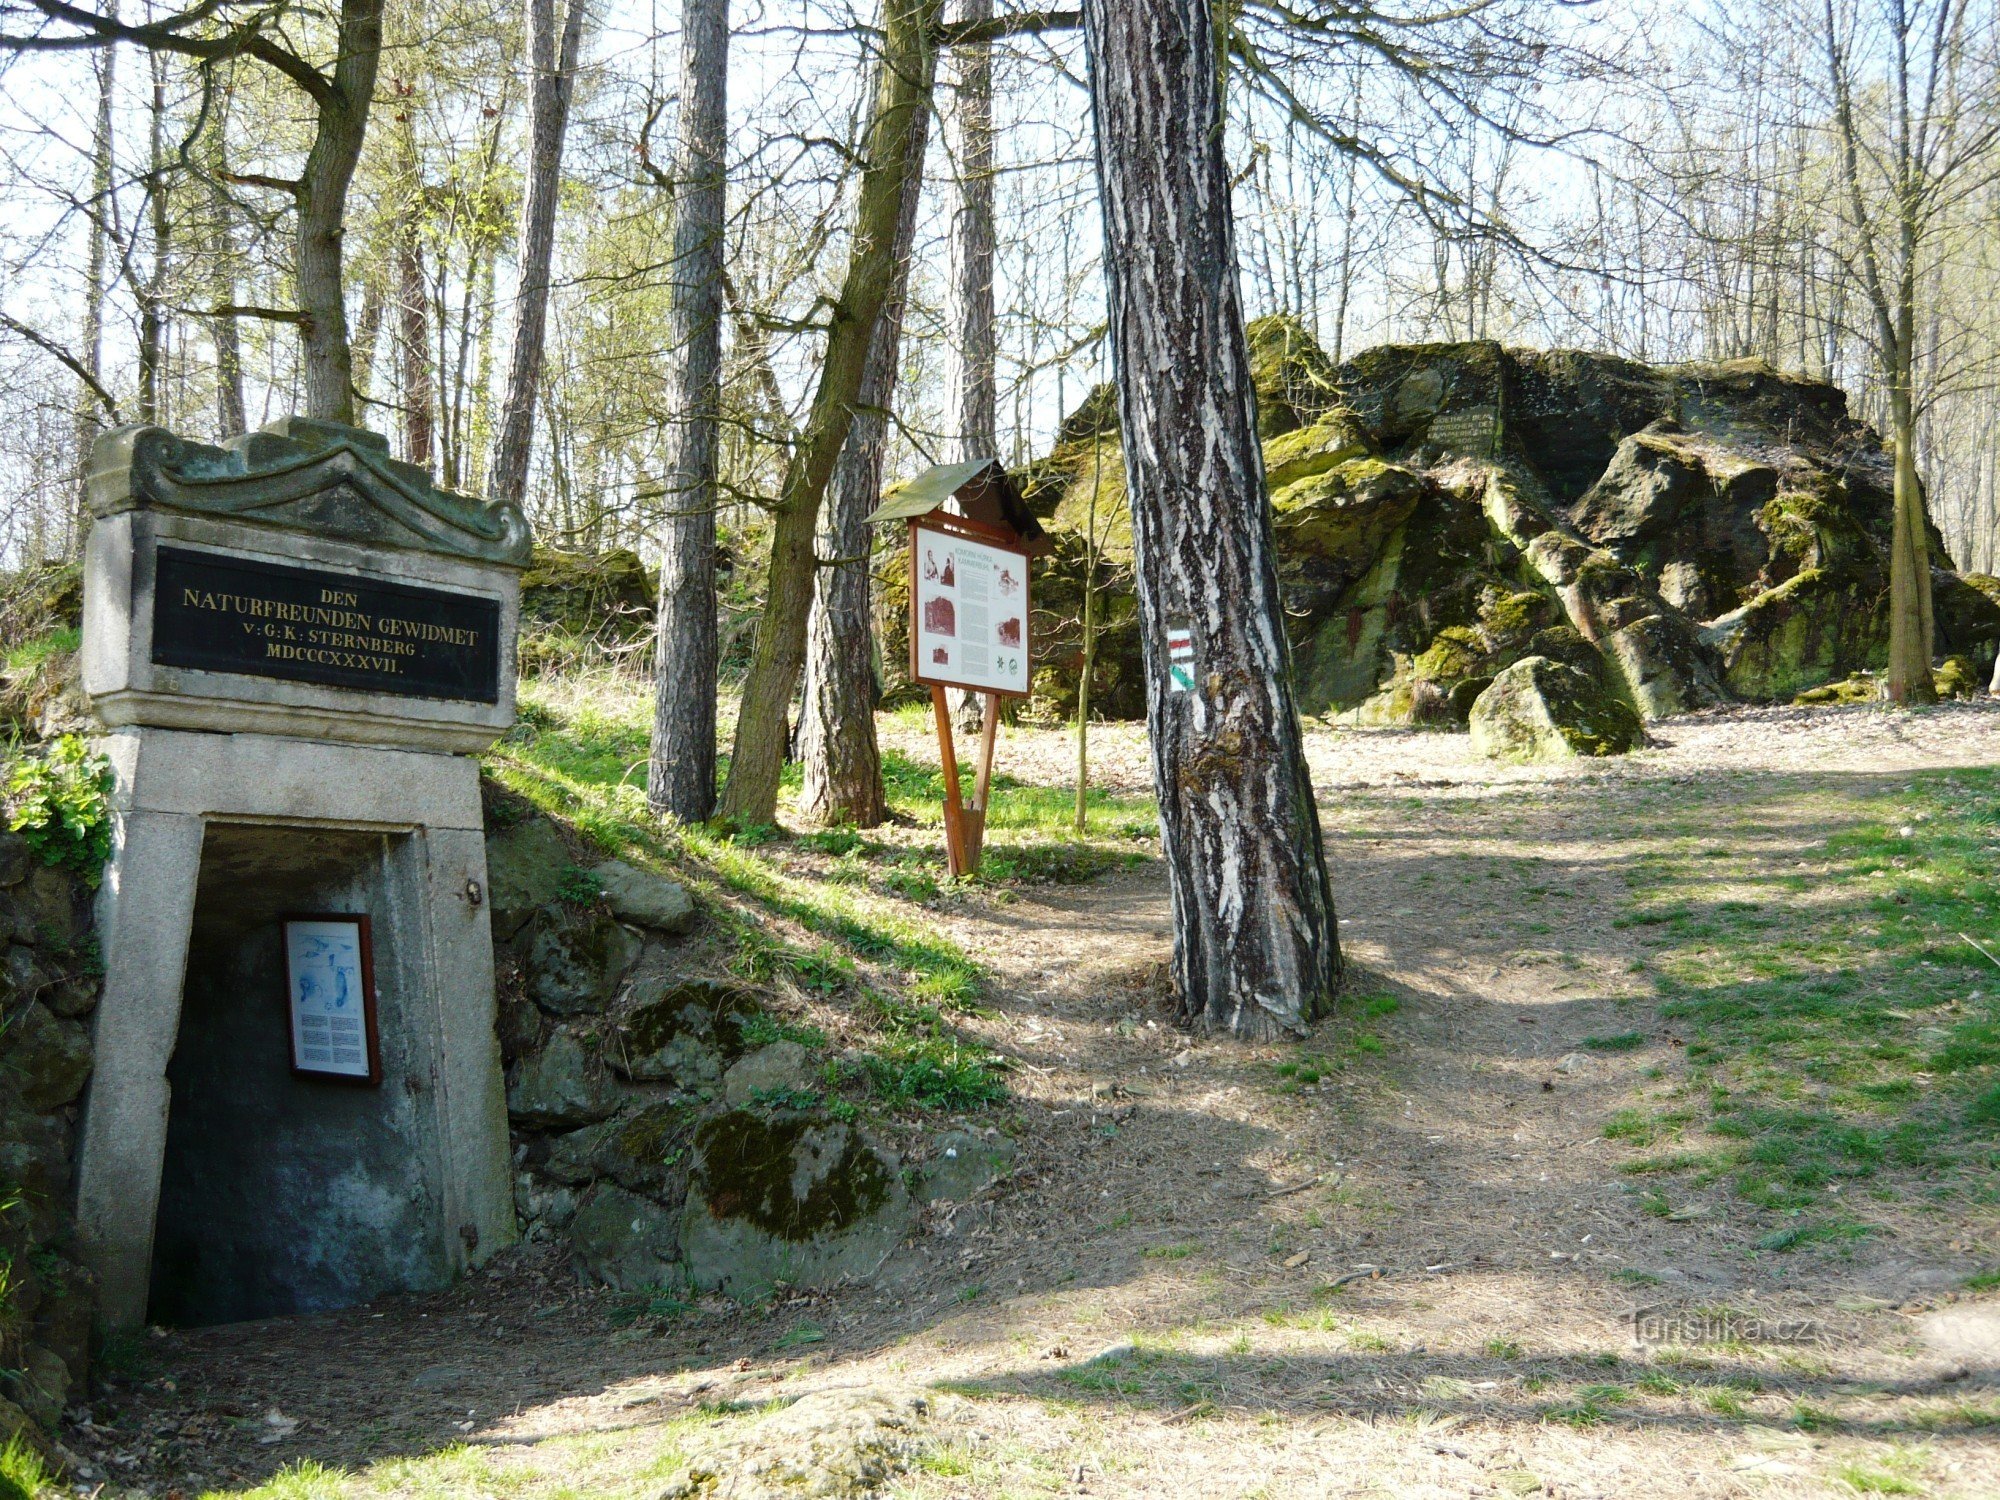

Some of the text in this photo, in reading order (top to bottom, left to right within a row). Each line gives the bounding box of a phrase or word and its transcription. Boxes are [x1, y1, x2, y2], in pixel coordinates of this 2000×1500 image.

[321, 588, 358, 608] DEN
[183, 588, 480, 648] NATURFREUNDEN GEWIDMET
[266, 643, 404, 675] MDCCCXXXVII.
